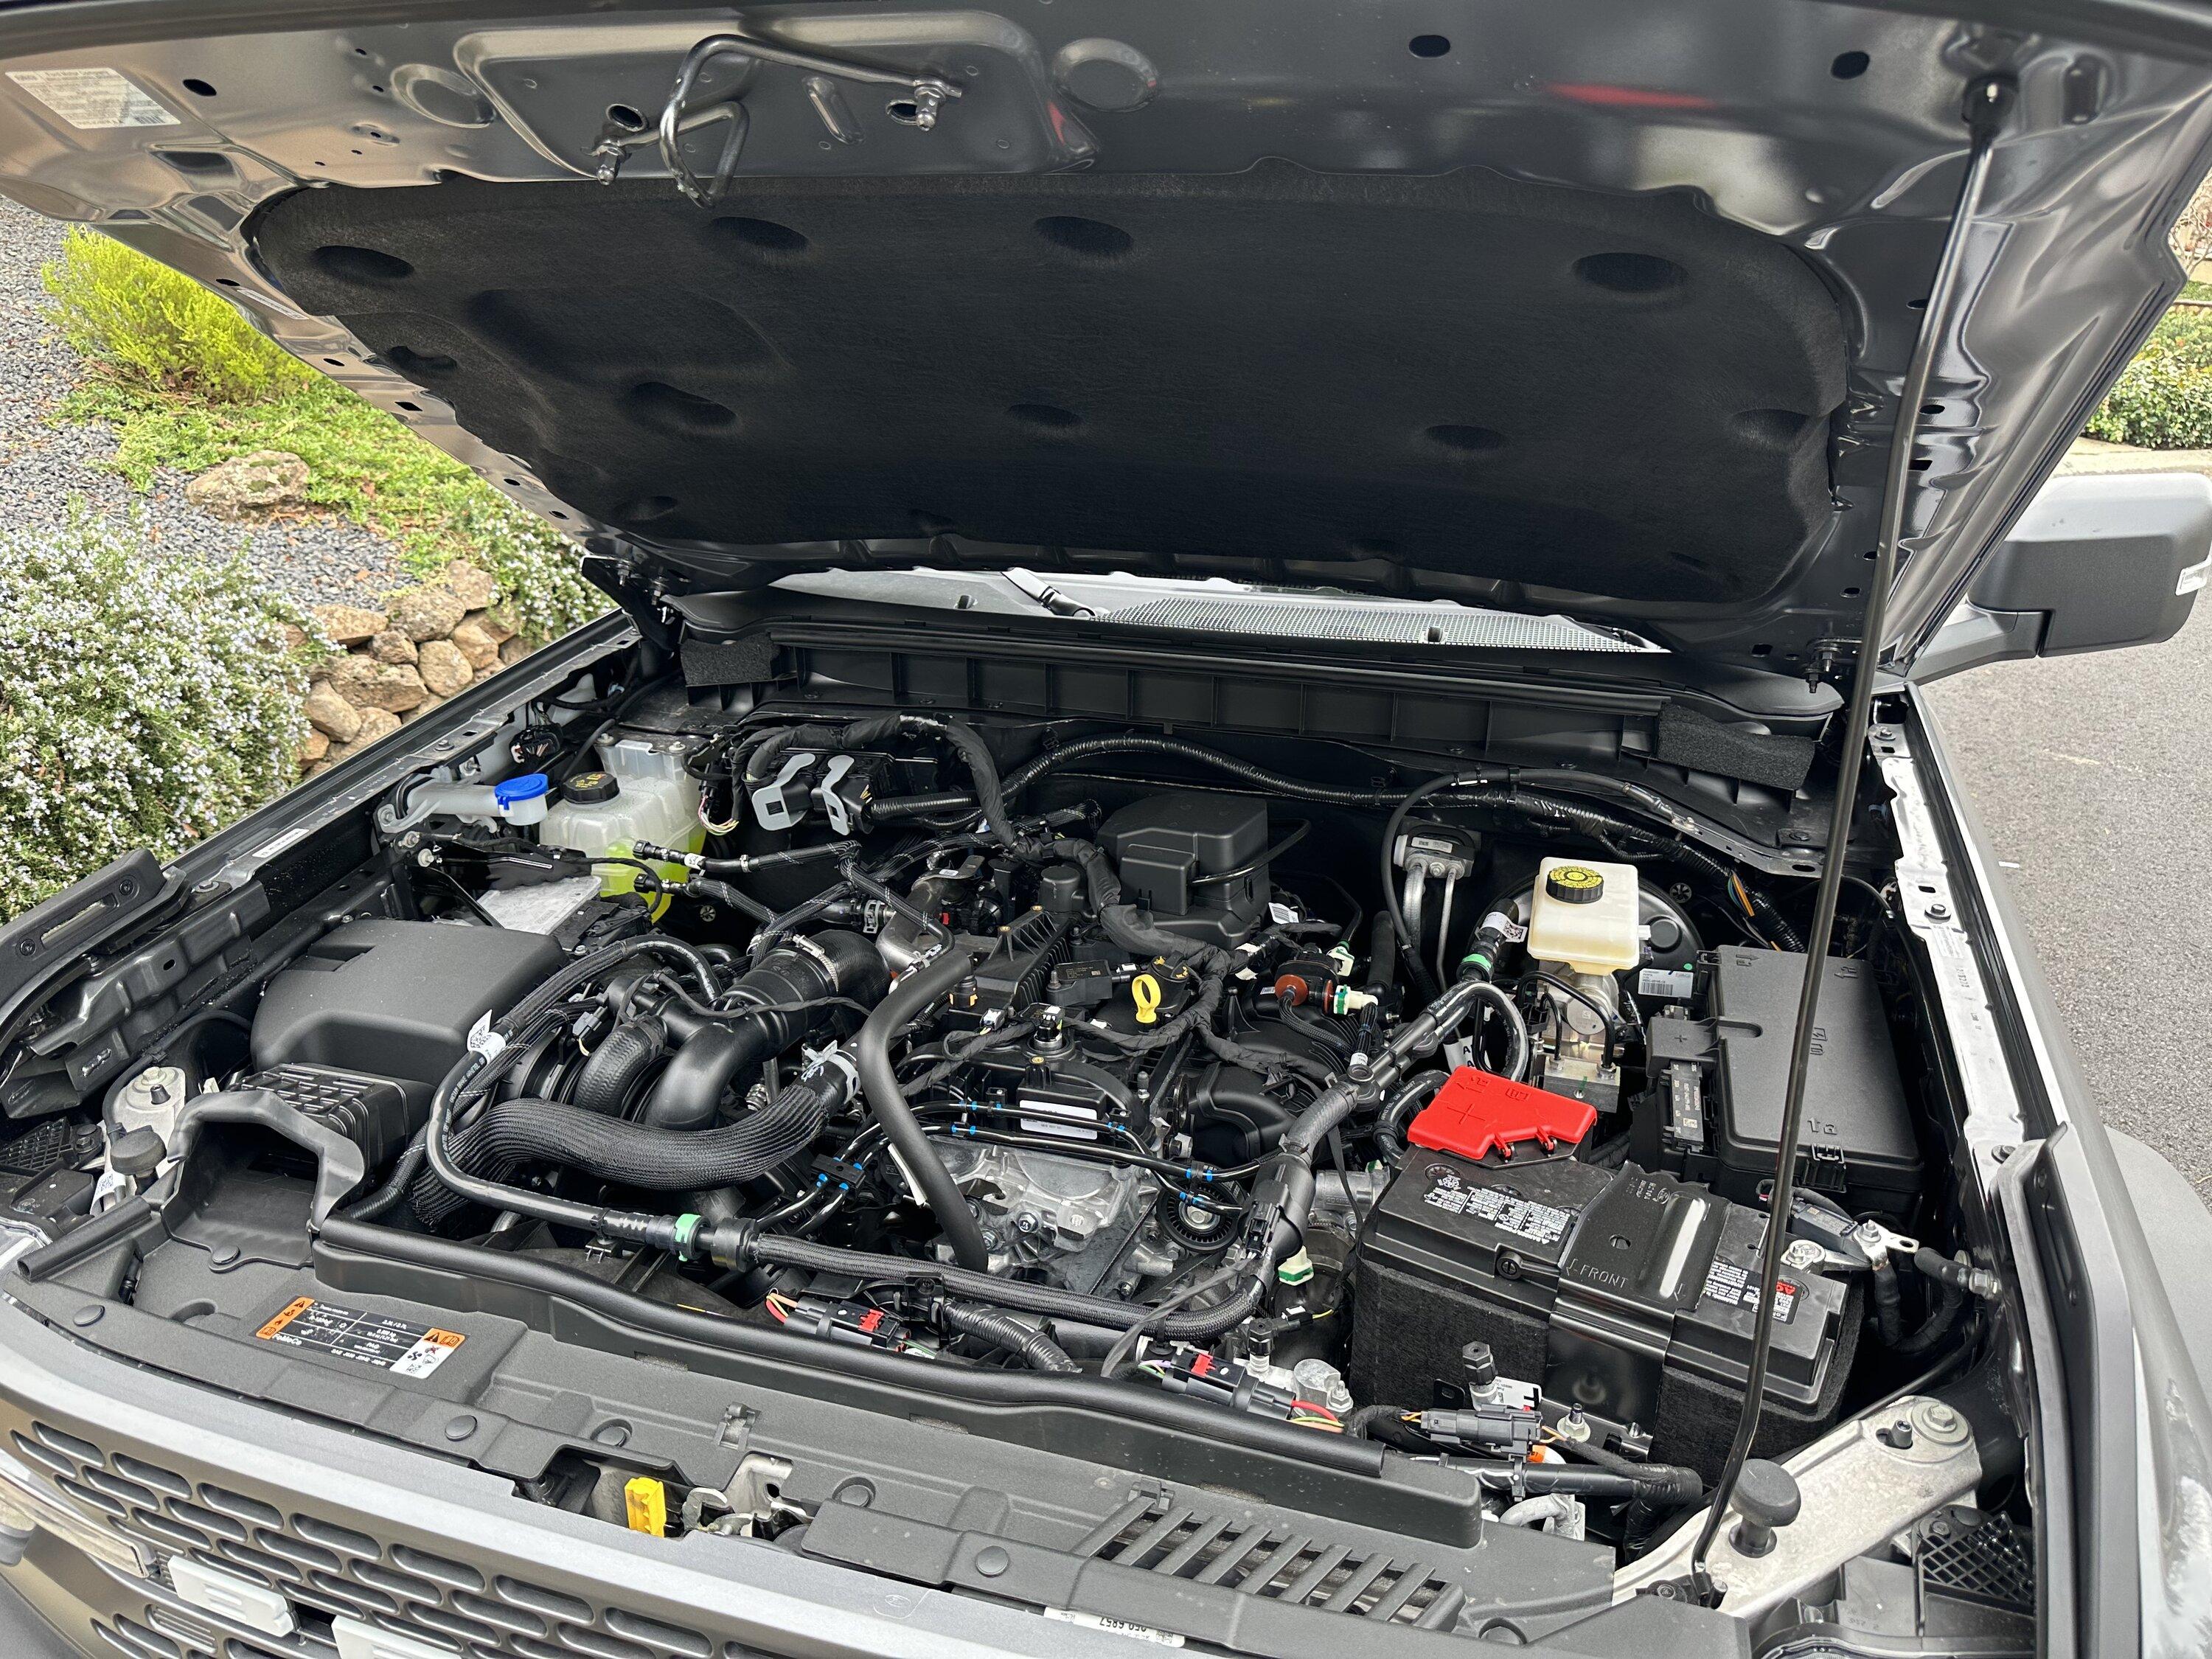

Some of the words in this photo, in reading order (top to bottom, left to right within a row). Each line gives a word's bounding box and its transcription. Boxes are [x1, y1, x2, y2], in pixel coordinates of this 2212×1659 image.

[1579, 1265, 1629, 1289] FRONT
[272, 1333, 302, 1346] FoMoCo
[1099, 1616, 1125, 1630] 6857
